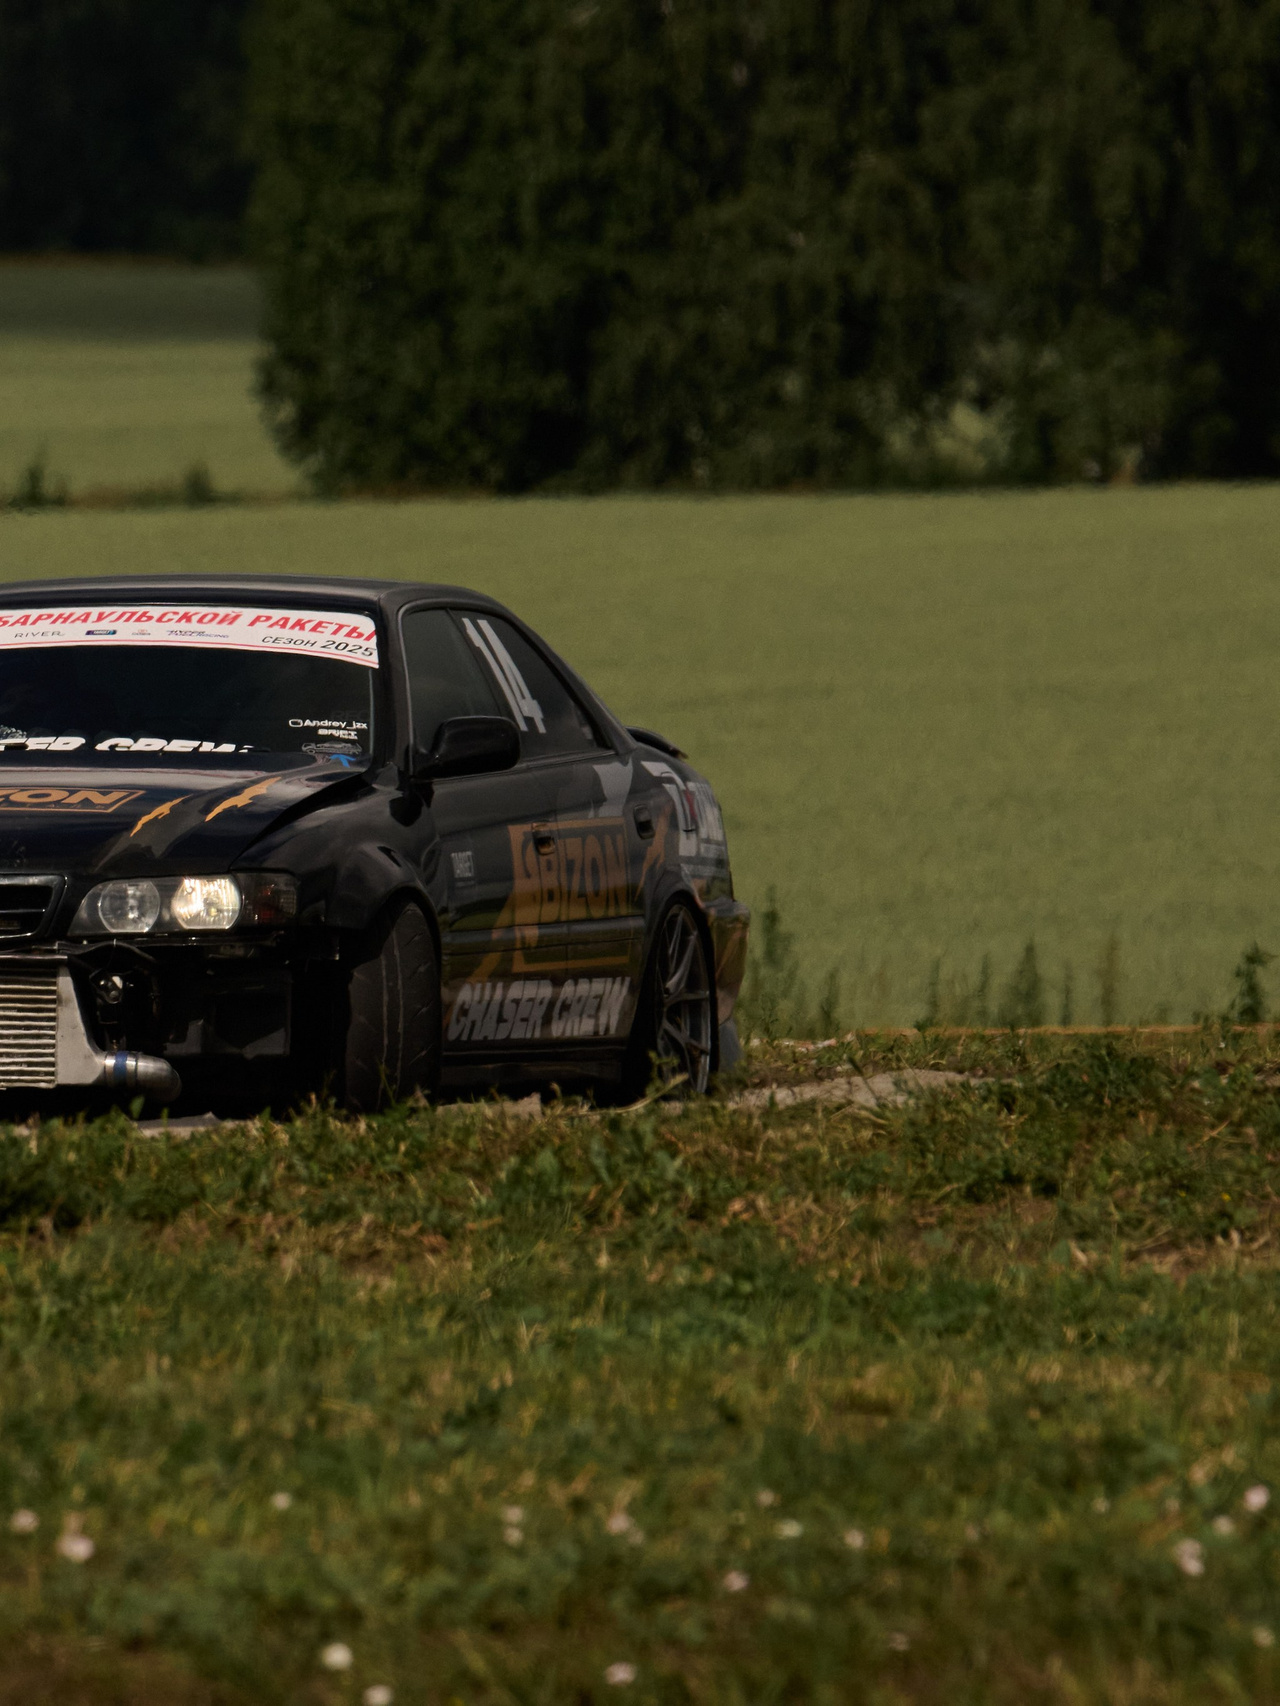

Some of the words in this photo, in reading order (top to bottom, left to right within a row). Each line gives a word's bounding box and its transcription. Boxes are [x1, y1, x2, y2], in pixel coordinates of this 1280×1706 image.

[14, 630, 64, 639] RIVER
[247, 614, 376, 642] РАКЕТЫ
[261, 635, 318, 648] СЕЗОН
[320, 640, 376, 657] 2025
[303, 719, 368, 730] Andrey_jzx
[538, 834, 629, 924] BIZON
[447, 980, 553, 1041] CHASER
[551, 977, 632, 1037] CREW
